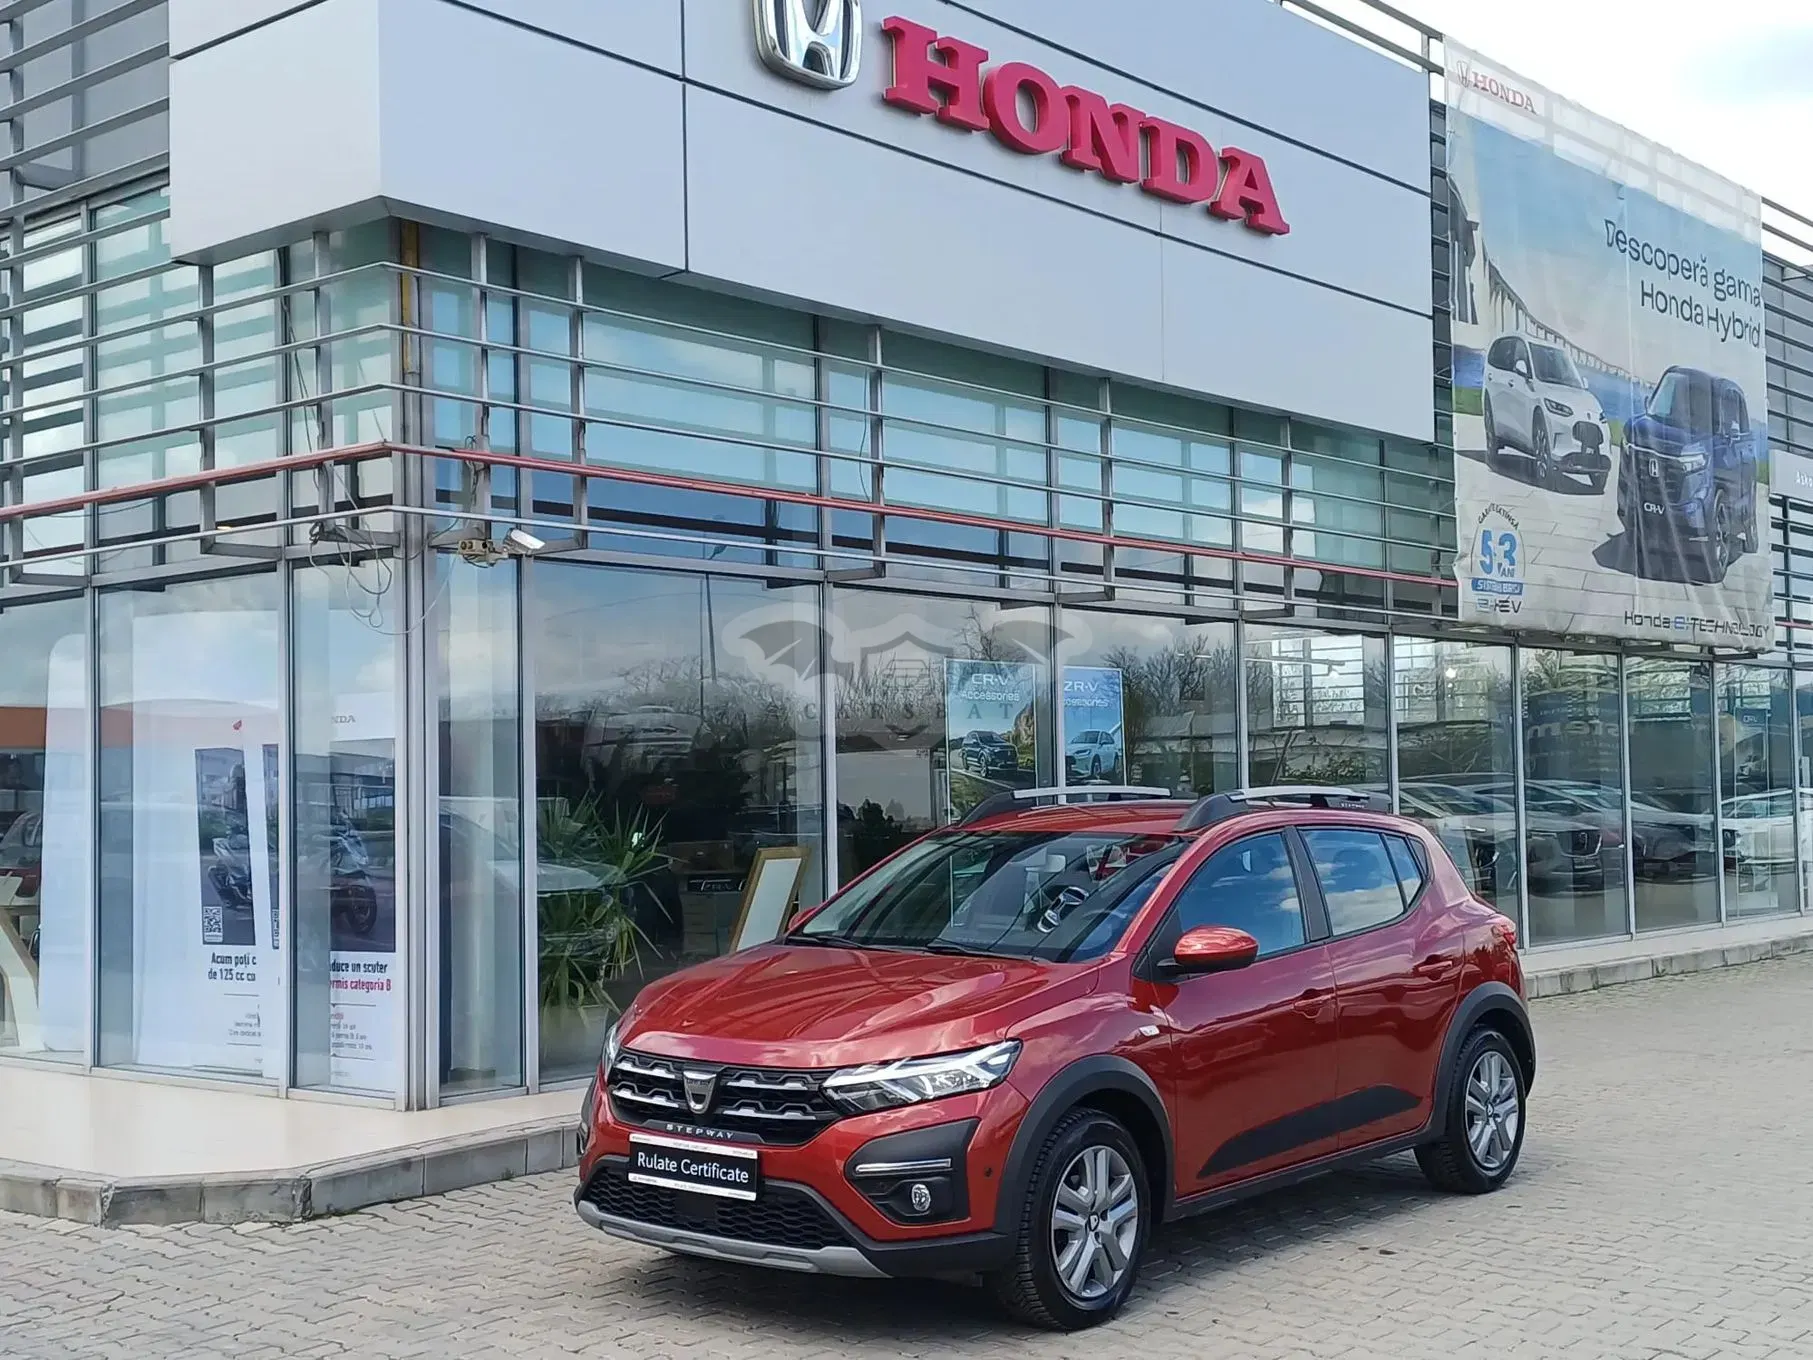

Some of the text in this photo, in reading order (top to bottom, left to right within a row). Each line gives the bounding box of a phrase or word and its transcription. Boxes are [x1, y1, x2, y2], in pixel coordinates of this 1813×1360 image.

[1471, 71, 1537, 115] HONDA
[881, 15, 1291, 237] HONDA
[1604, 218, 1762, 308] Descoperă gama
[1640, 280, 1761, 349] Honda Hybrid
[1624, 611, 1671, 629] Honda
[959, 690, 1020, 702] Accessories
[211, 952, 233, 965] Acum
[207, 968, 256, 982] de 125 cc cu
[351, 962, 361, 973] un
[363, 962, 388, 974] scuter
[349, 979, 384, 993] categoria
[385, 979, 392, 992] B
[666, 1123, 735, 1139] STEPWAY
[637, 1151, 749, 1184] Rulate Certificate
